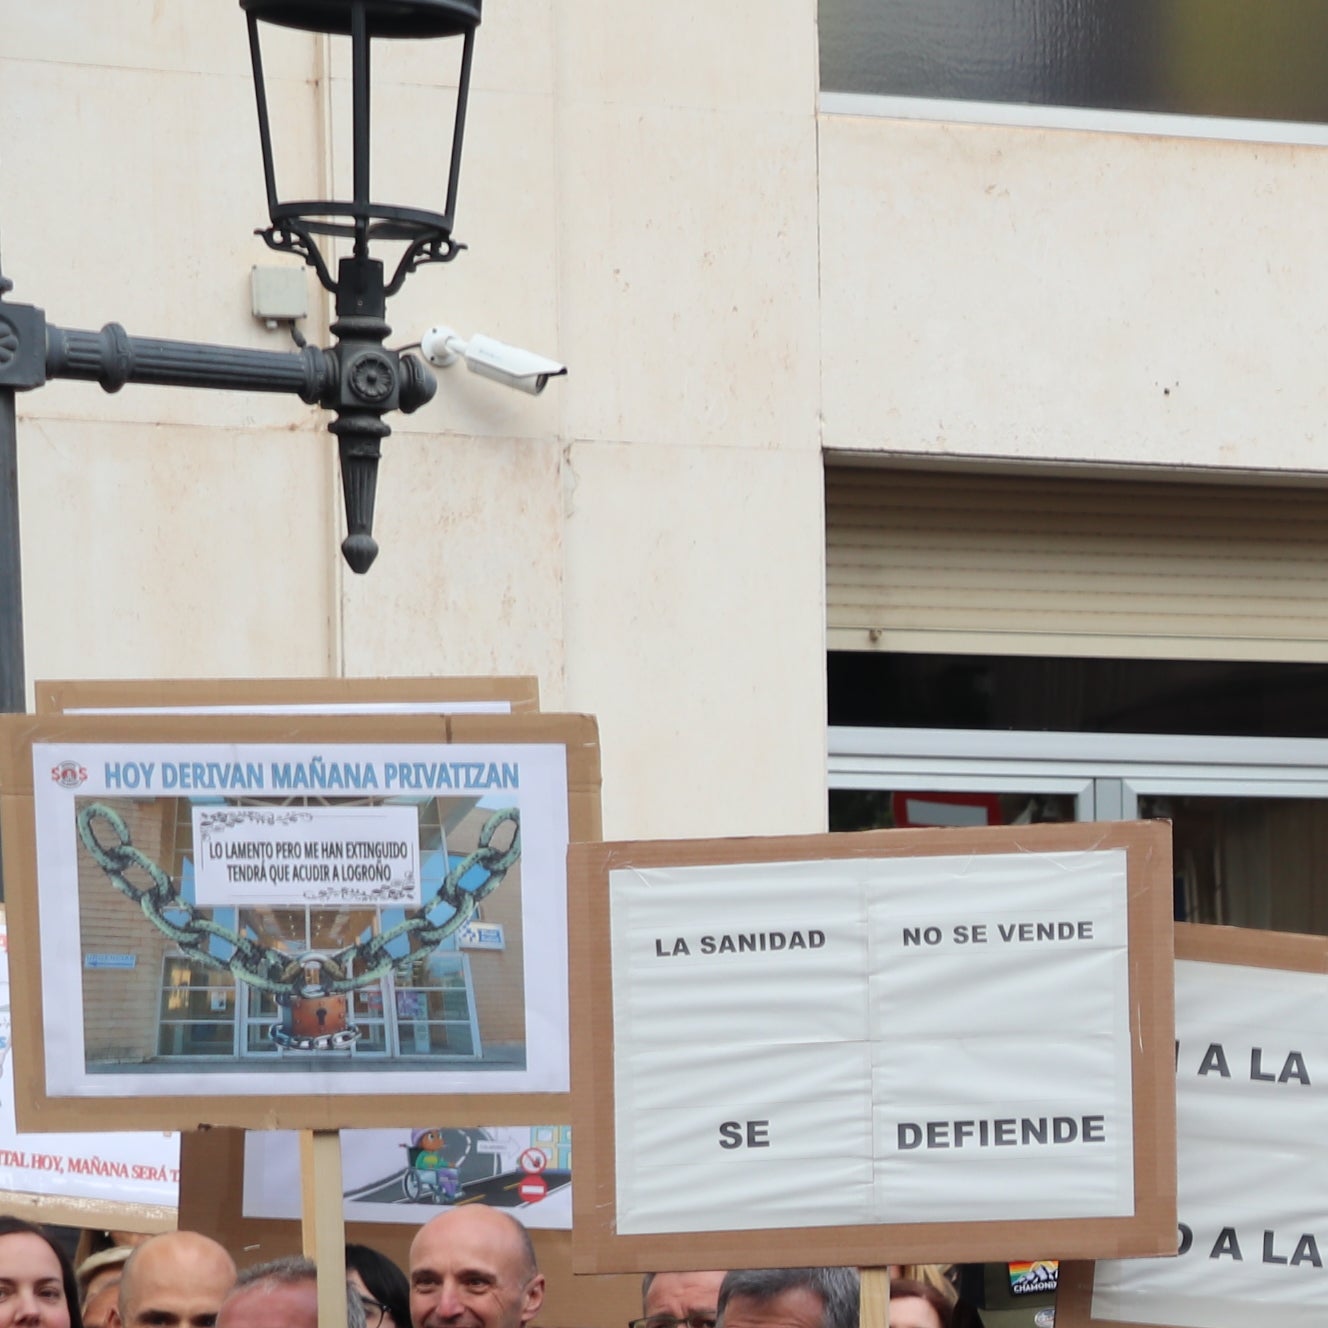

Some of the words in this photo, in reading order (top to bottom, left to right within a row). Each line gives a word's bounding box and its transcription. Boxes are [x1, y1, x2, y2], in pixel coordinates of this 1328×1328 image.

[104, 762, 155, 788] HOY
[162, 762, 264, 789] DERIVAN
[271, 756, 378, 788] MAÑANA
[384, 762, 519, 788] PRIVATIZAN
[209, 842, 222, 859] LO
[225, 842, 273, 859] LAMENTO
[276, 842, 301, 859] PERO
[304, 842, 321, 859] ME
[324, 842, 343, 859] HAN
[345, 842, 407, 859] EXTINGUIDO
[227, 861, 267, 882] TENDRÁ
[269, 864, 290, 884] QUE
[292, 864, 330, 881] ACUDIR
[332, 865, 341, 881] A
[342, 859, 391, 881] LOGROÑO
[656, 937, 690, 957] LA
[700, 929, 826, 955] SANIDAD
[903, 926, 942, 947] NO
[953, 924, 988, 945] SE
[998, 921, 1094, 943] VENDE
[1197, 1042, 1231, 1078] A
[1250, 1046, 1312, 1086] LA
[719, 1120, 770, 1149] SE
[897, 1115, 1105, 1150] DEFIENDE
[31, 1153, 64, 1174] HOY,
[68, 1156, 129, 1178] MAÑANA
[131, 1165, 167, 1182] SERÁ
[1209, 1226, 1243, 1261] A
[1263, 1229, 1323, 1268] LA
